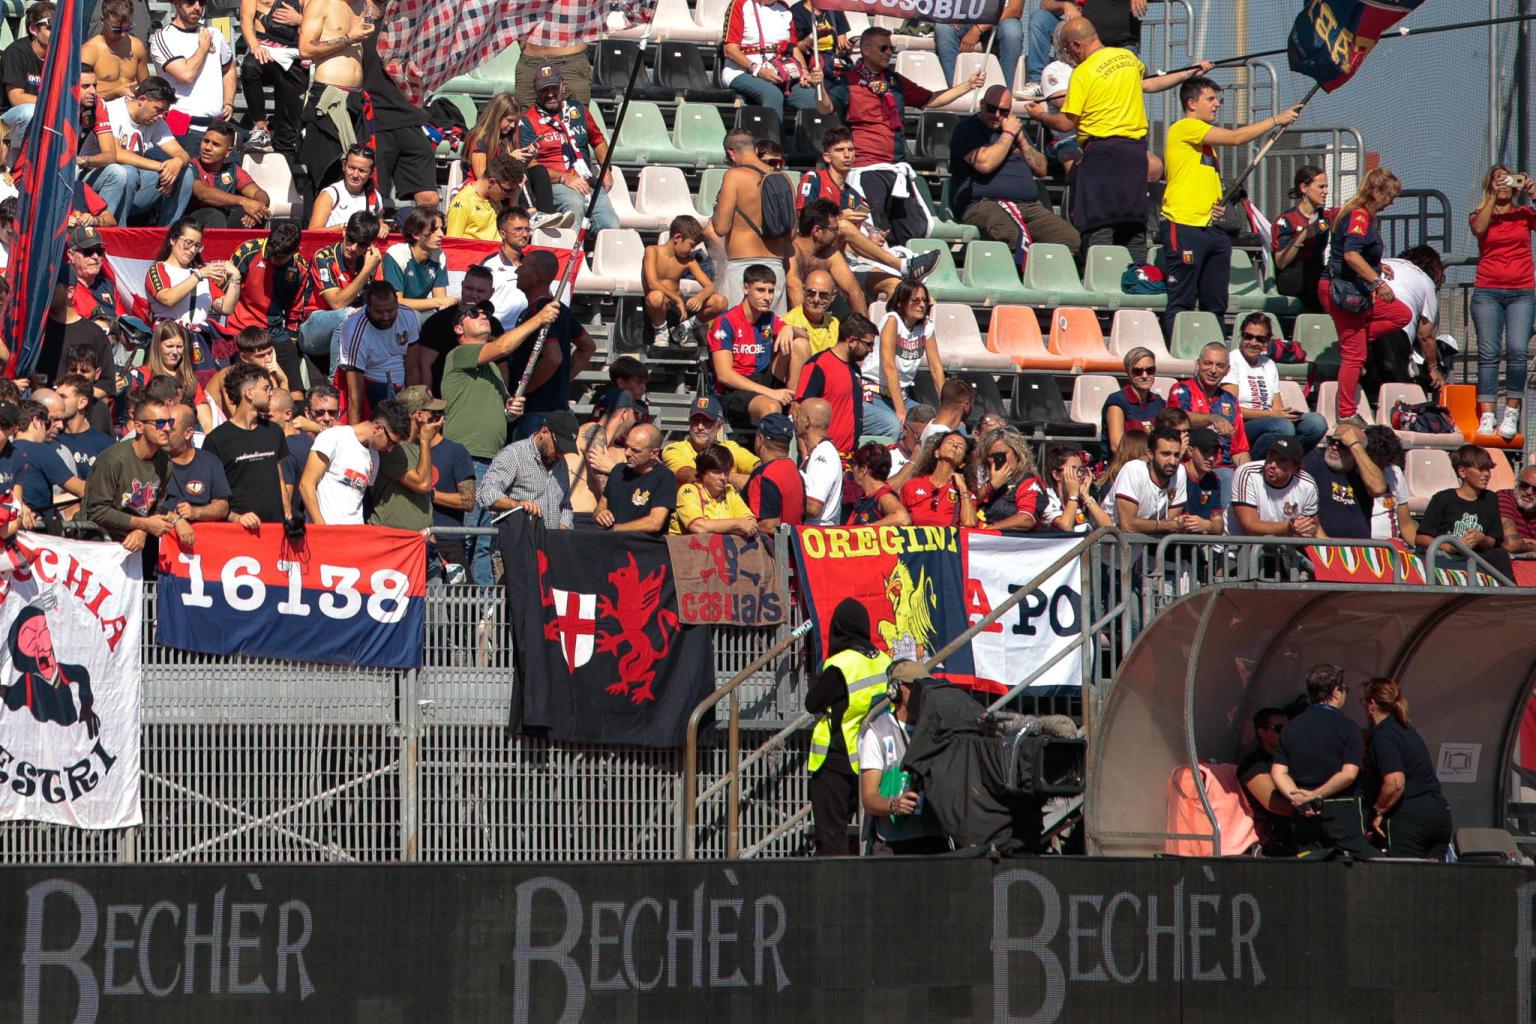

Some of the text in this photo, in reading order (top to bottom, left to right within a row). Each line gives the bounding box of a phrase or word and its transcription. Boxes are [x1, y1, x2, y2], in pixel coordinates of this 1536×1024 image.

[802, 525, 957, 558] OREGINI
[177, 552, 410, 623] 16138
[681, 592, 782, 623] casuals
